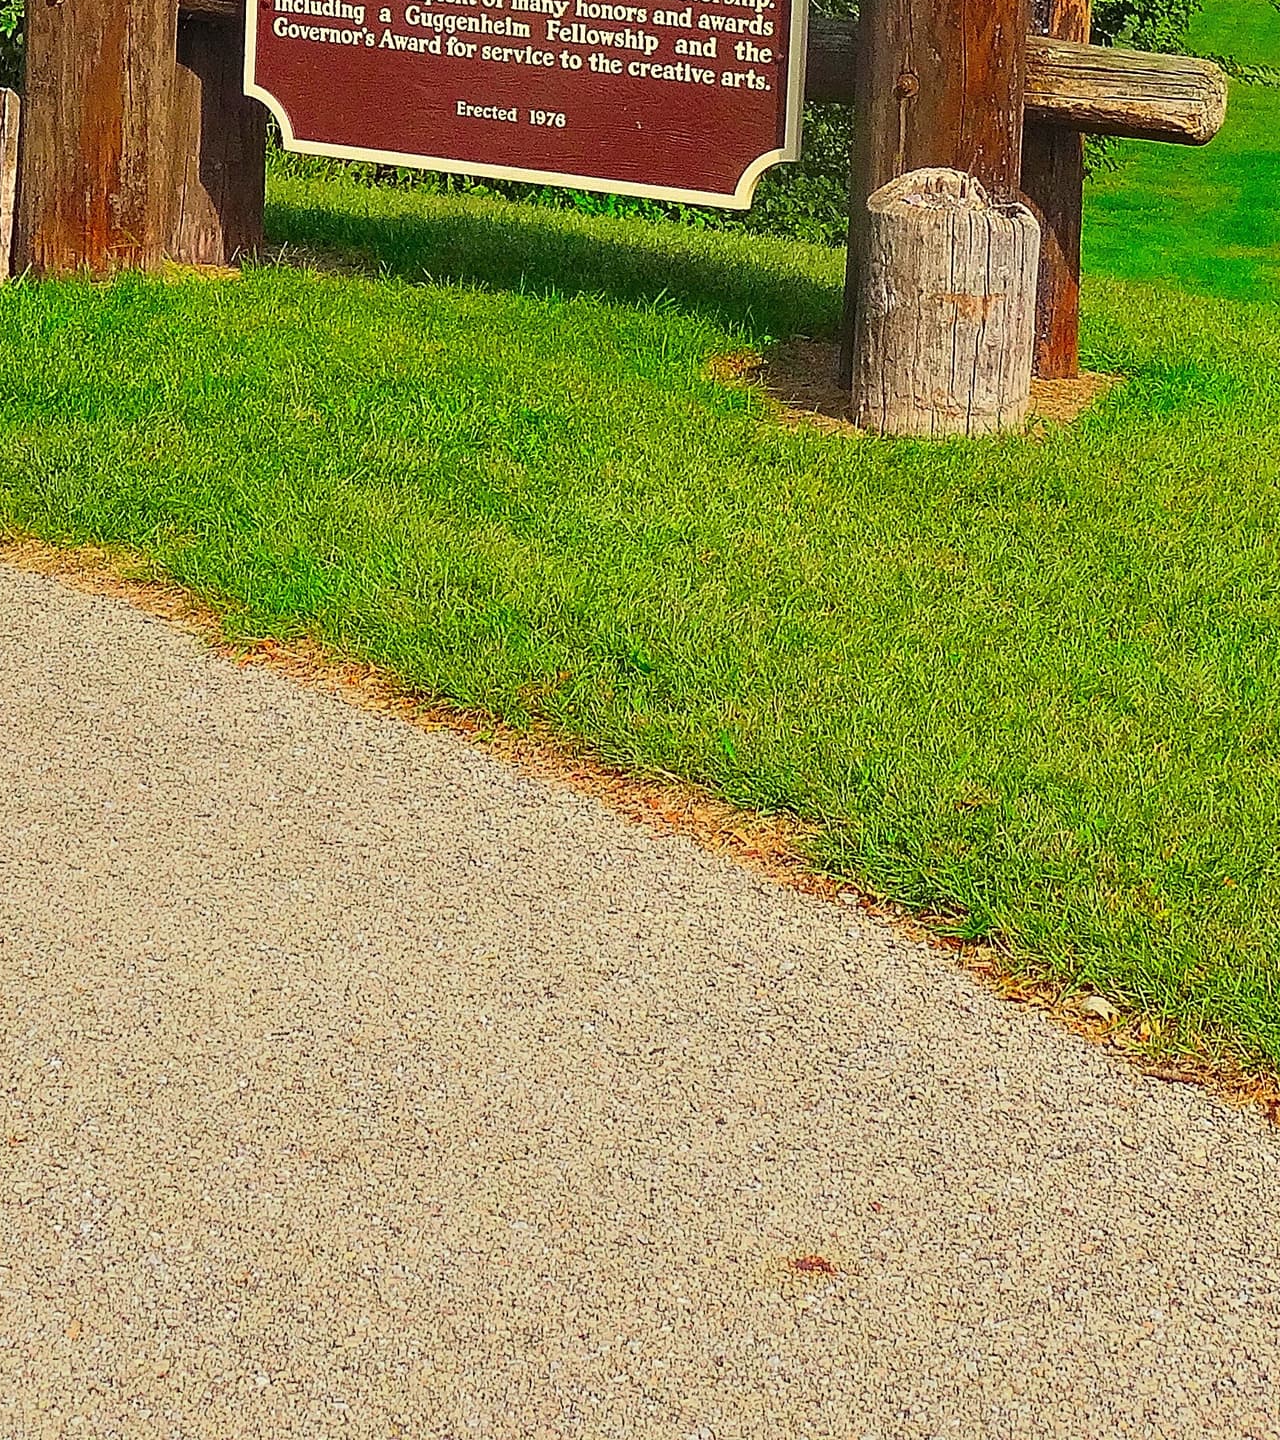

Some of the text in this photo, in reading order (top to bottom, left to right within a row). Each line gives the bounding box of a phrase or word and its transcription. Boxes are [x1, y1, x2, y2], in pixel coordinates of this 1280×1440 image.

[272, 16, 771, 91] Governor's Award for service to the creative arts.
[378, 7, 392, 22] a
[404, 4, 530, 38] Guggenheim
[545, 19, 659, 55] Fellowship
[674, 36, 717, 58] and
[733, 40, 772, 63] the
[456, 100, 566, 127] Erected 1976
